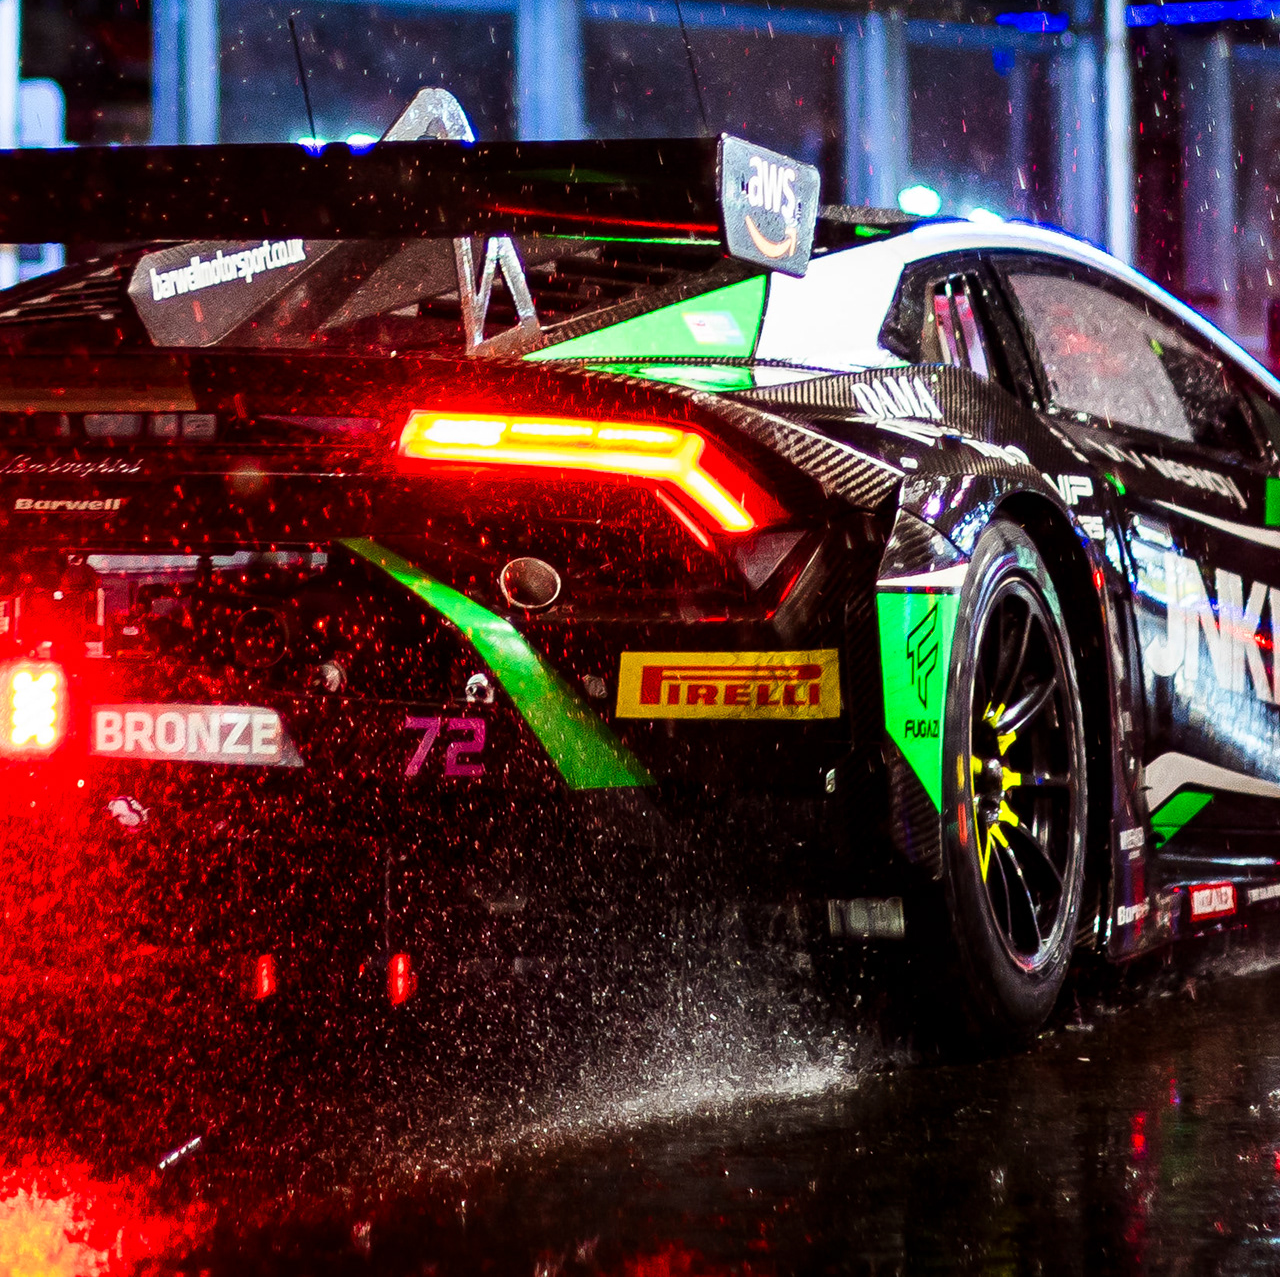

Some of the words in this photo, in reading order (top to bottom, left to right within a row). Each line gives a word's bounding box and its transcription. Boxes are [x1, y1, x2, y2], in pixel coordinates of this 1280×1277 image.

[748, 155, 796, 222] aws
[149, 238, 307, 302] barwellmotorsport.co.uk
[14, 497, 122, 512] Barwell
[638, 664, 824, 706] PIRELLI
[95, 710, 280, 756] BRONZE
[404, 716, 487, 777] 72
